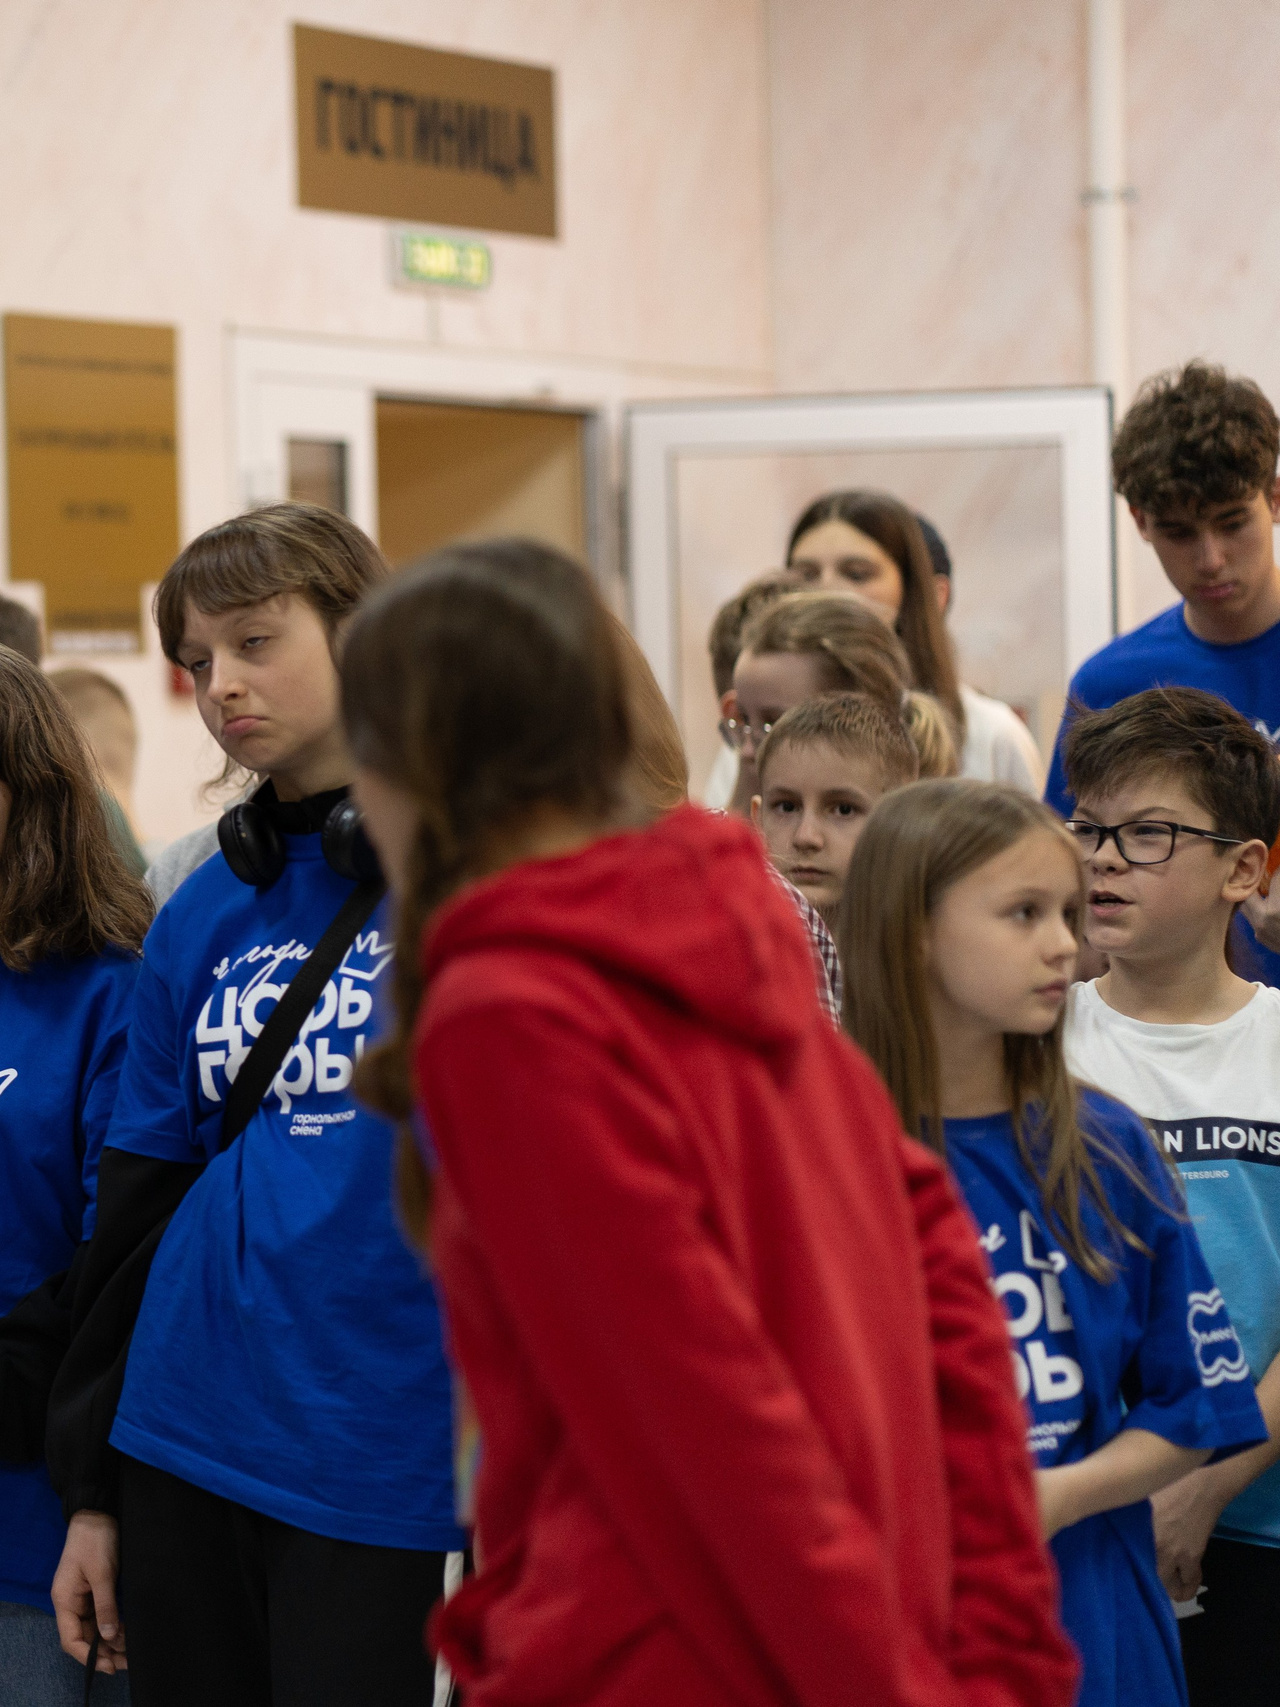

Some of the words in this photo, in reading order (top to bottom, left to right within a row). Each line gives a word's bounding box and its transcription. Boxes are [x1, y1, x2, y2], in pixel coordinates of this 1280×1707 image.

[315, 76, 540, 192] ГОСТИНИЦА
[289, 1125, 324, 1137] смена
[1196, 1126, 1280, 1156] LIONS
[1173, 1169, 1230, 1181] TERSBURG
